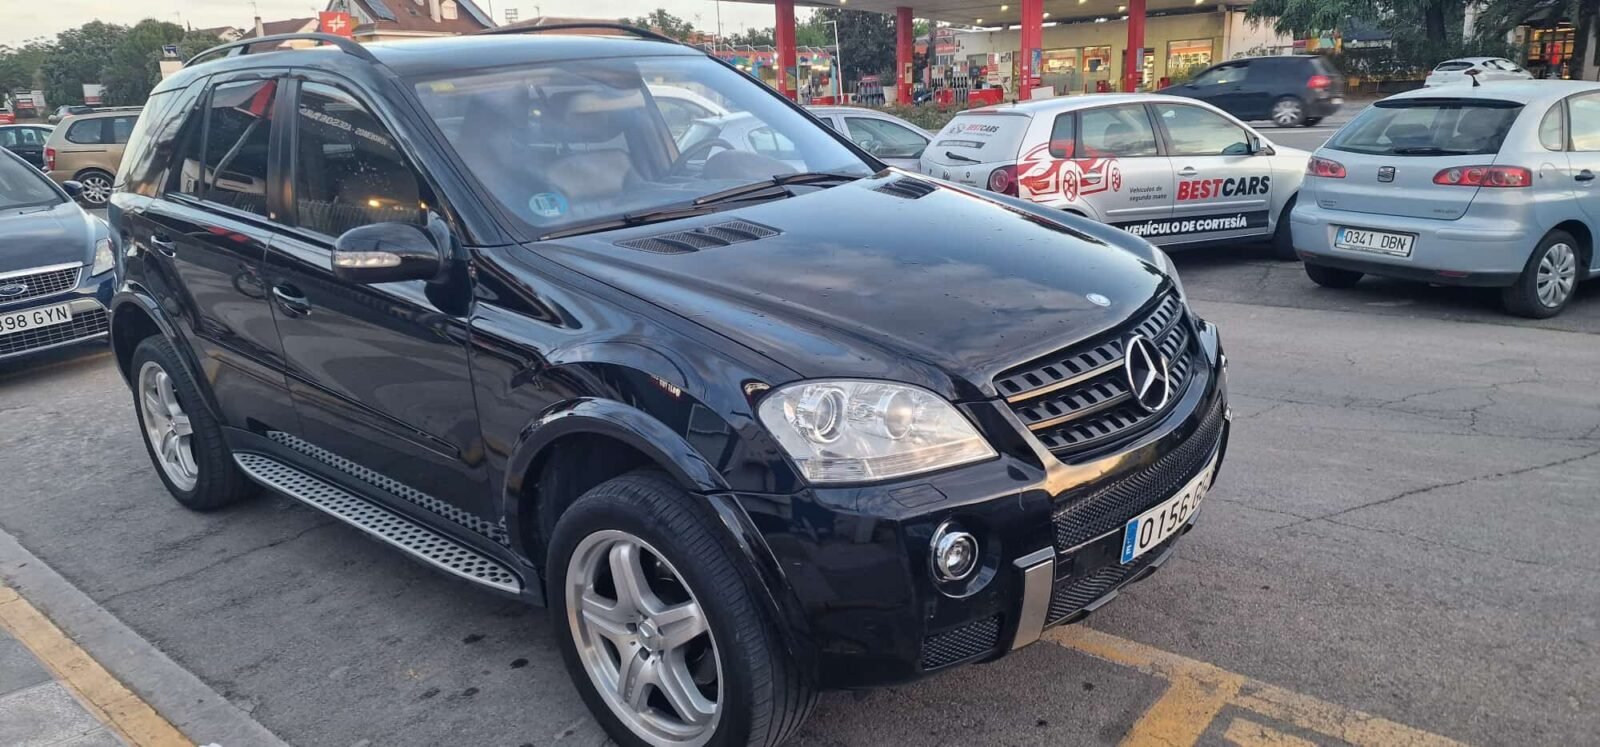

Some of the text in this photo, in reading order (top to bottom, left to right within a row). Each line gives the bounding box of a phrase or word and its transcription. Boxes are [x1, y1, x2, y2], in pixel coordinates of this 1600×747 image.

[1177, 175, 1270, 201] BESTCARS
[1125, 214, 1247, 236] VEHÍCULO DE CORTESÍA
[1344, 230, 1406, 250] 0341 DBN
[33, 306, 68, 325] GYN
[1139, 493, 1191, 549] 0156
